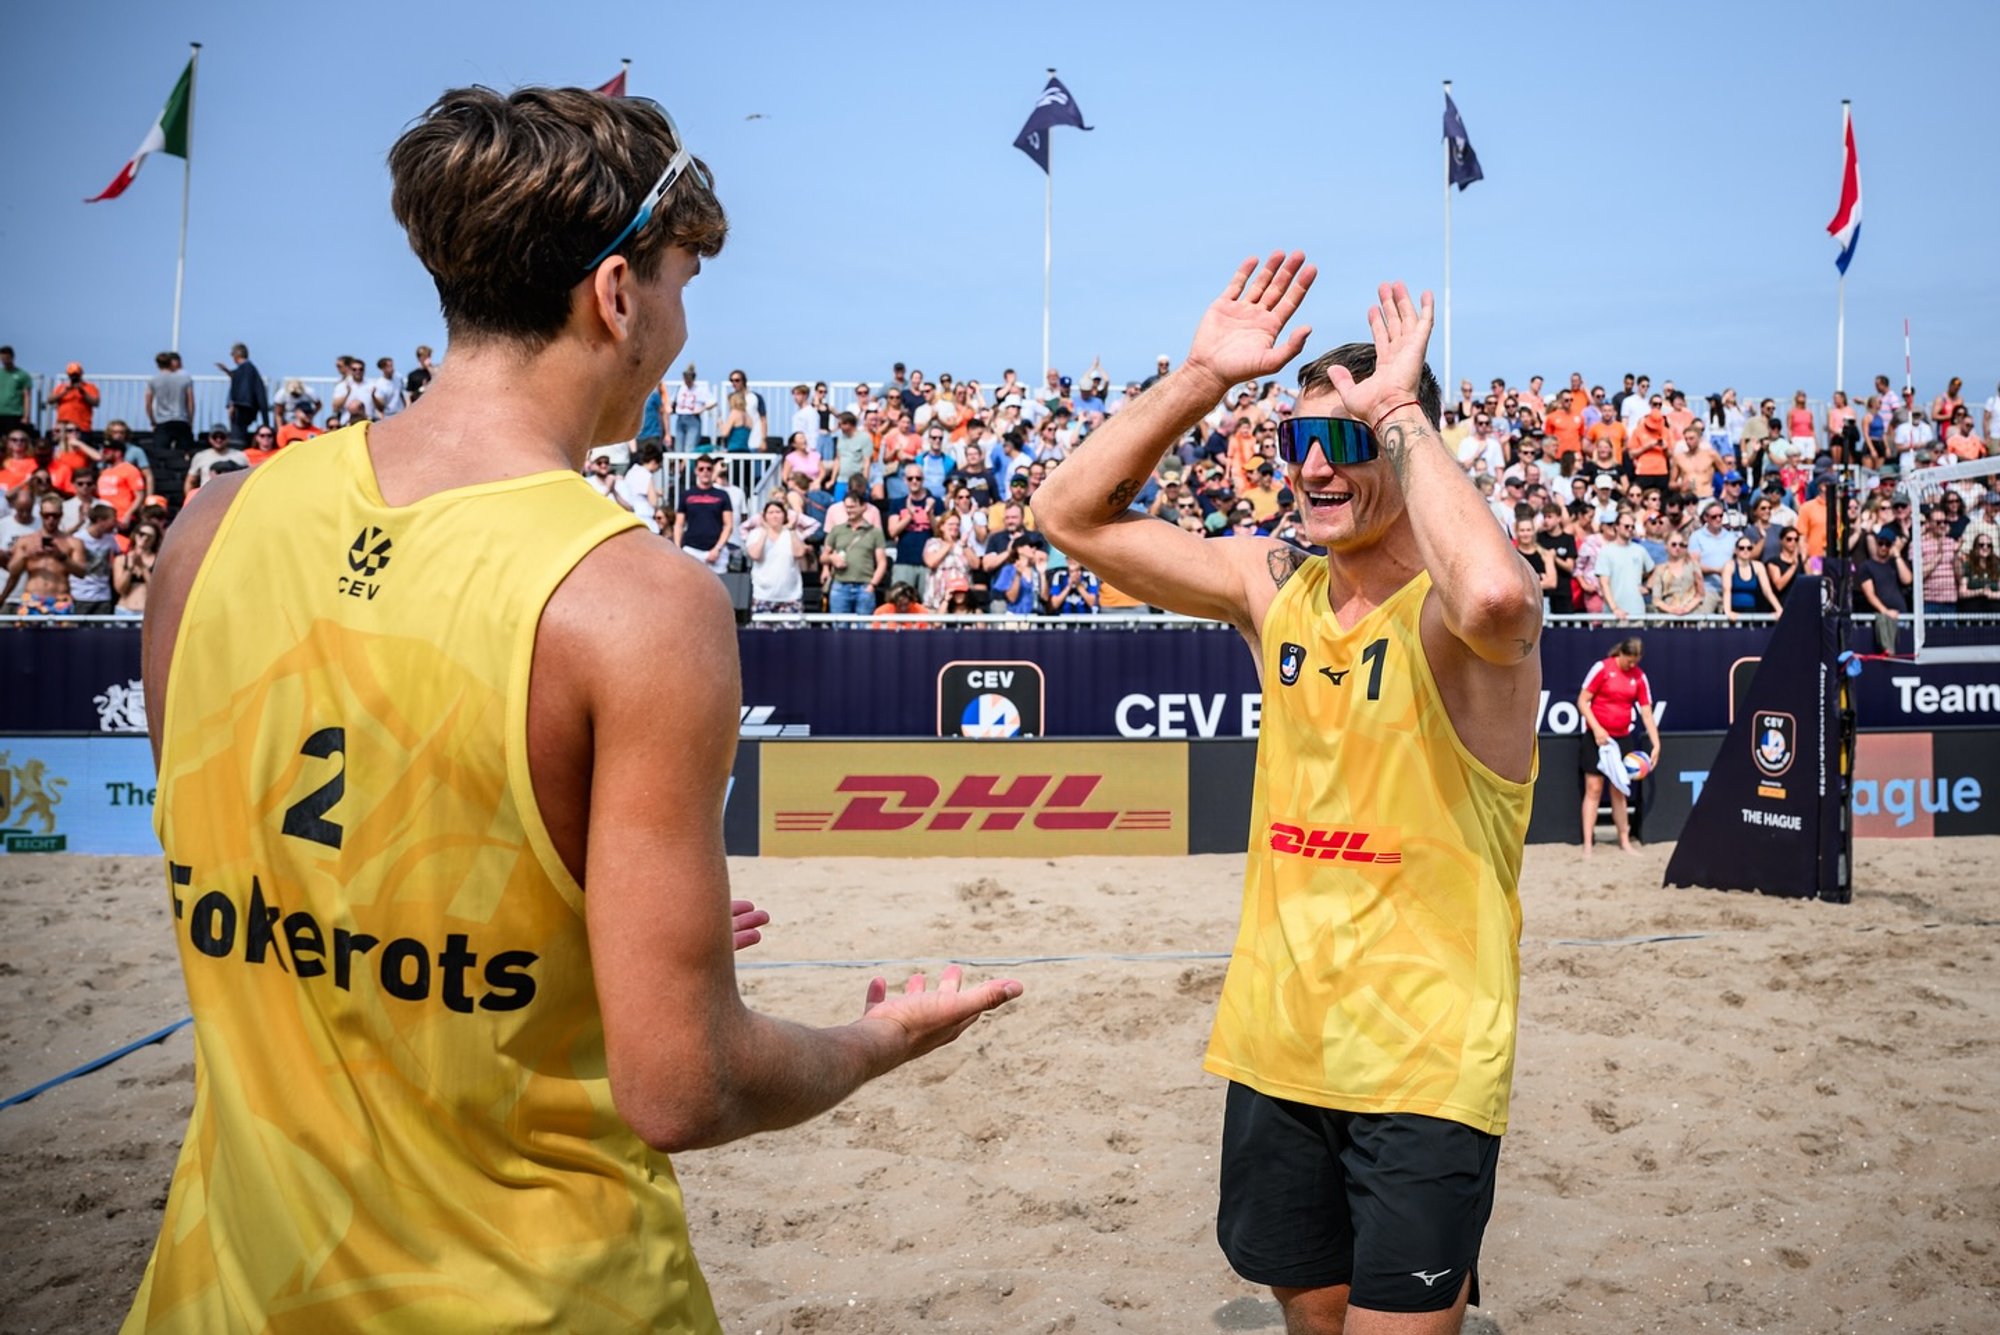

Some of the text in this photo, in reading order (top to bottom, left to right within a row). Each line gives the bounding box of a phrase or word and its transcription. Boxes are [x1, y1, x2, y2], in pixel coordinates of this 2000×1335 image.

[338, 576, 380, 600] CEV
[967, 670, 1014, 689] CEV
[1361, 638, 1389, 700] 1
[1115, 693, 1227, 737] CEV
[1892, 677, 2000, 713] Team
[1763, 716, 1784, 728] CEV
[281, 726, 345, 850] 2
[830, 775, 1119, 830] DHL
[1851, 776, 1982, 827] ague
[1742, 808, 1802, 831] THE HAGUE
[1270, 822, 1370, 862] DHL
[169, 860, 540, 1013] Fokerots
